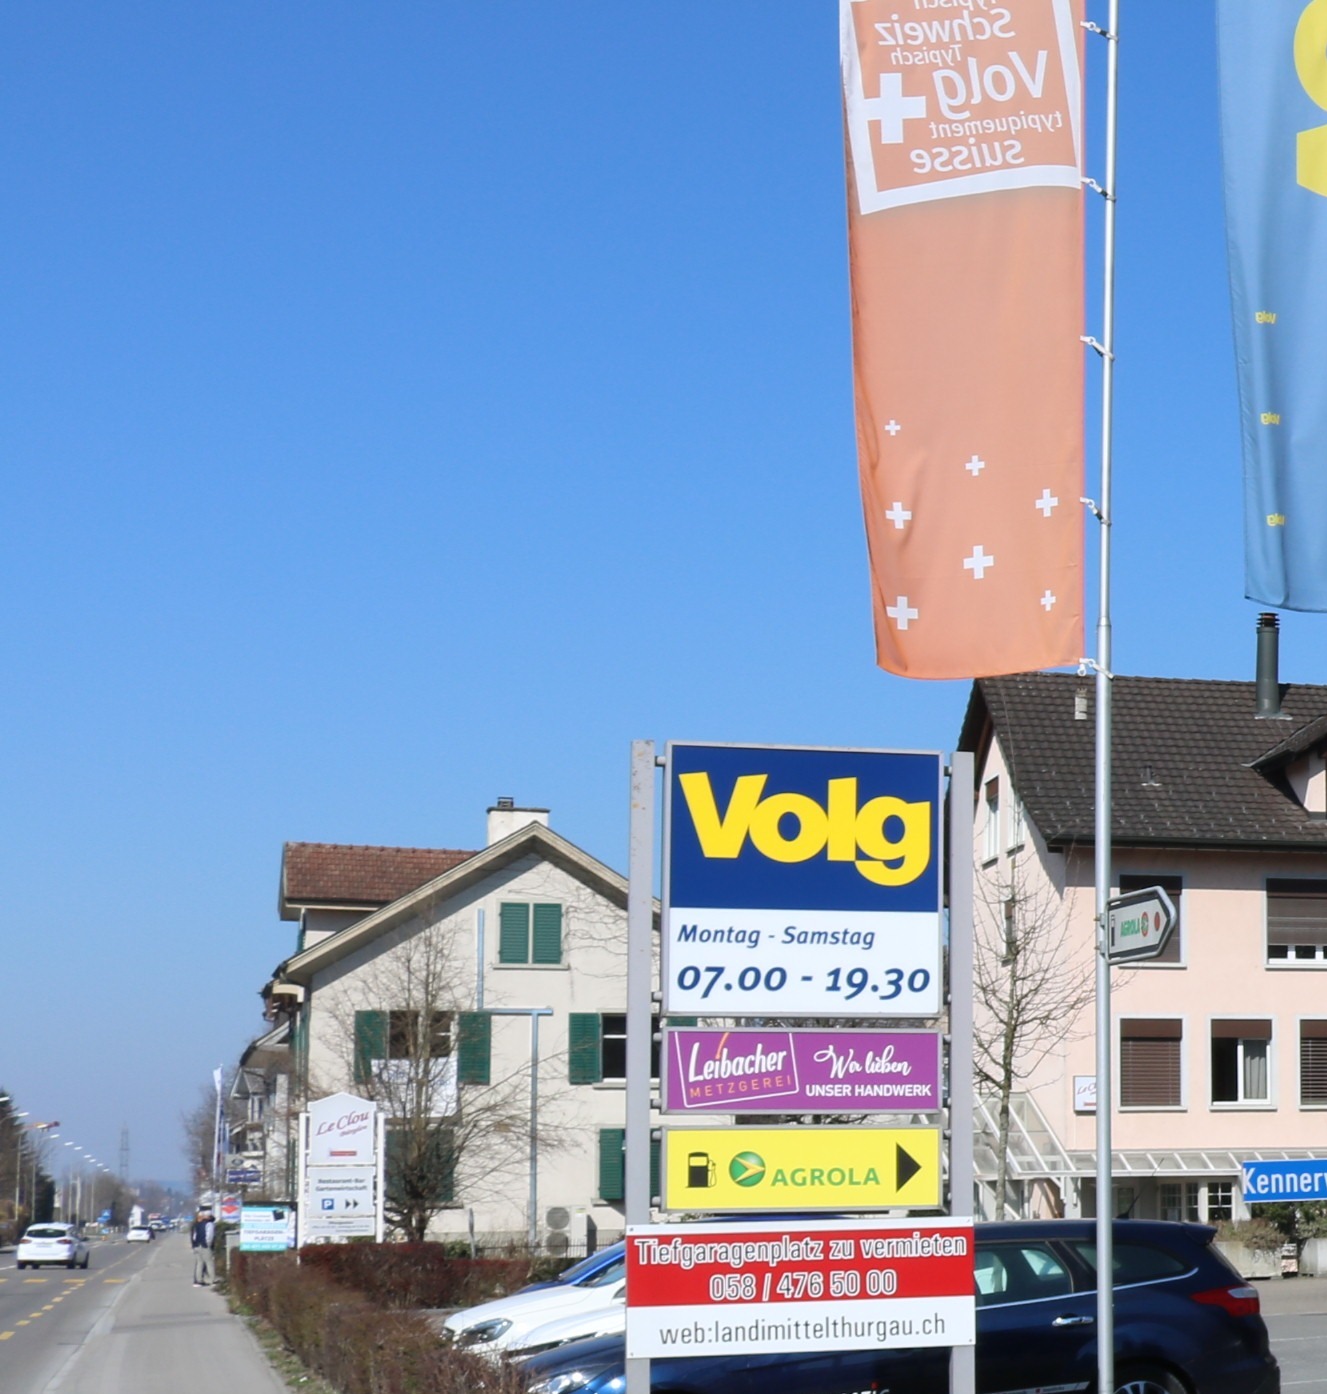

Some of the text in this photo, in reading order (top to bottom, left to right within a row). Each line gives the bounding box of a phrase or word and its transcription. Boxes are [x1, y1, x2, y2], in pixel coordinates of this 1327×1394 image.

[678, 771, 931, 887] Volg
[677, 924, 761, 948] Montag
[781, 926, 875, 950] Samstag
[677, 965, 787, 1000] 07.00
[825, 967, 931, 1000] 19.30
[688, 1042, 787, 1083] Leibacher
[865, 1044, 912, 1077] lieben
[690, 1075, 792, 1099] METZGEREI
[806, 1085, 931, 1097] UNSER HANDWERK
[315, 1110, 370, 1136] Le Clou
[770, 1167, 881, 1187] AGROLA
[634, 1232, 967, 1269] Tiefgaragenplatz zu vermieten
[710, 1269, 897, 1301] 058 / 476 50 00
[659, 1313, 945, 1345] web:landimittelthurgau.ch
